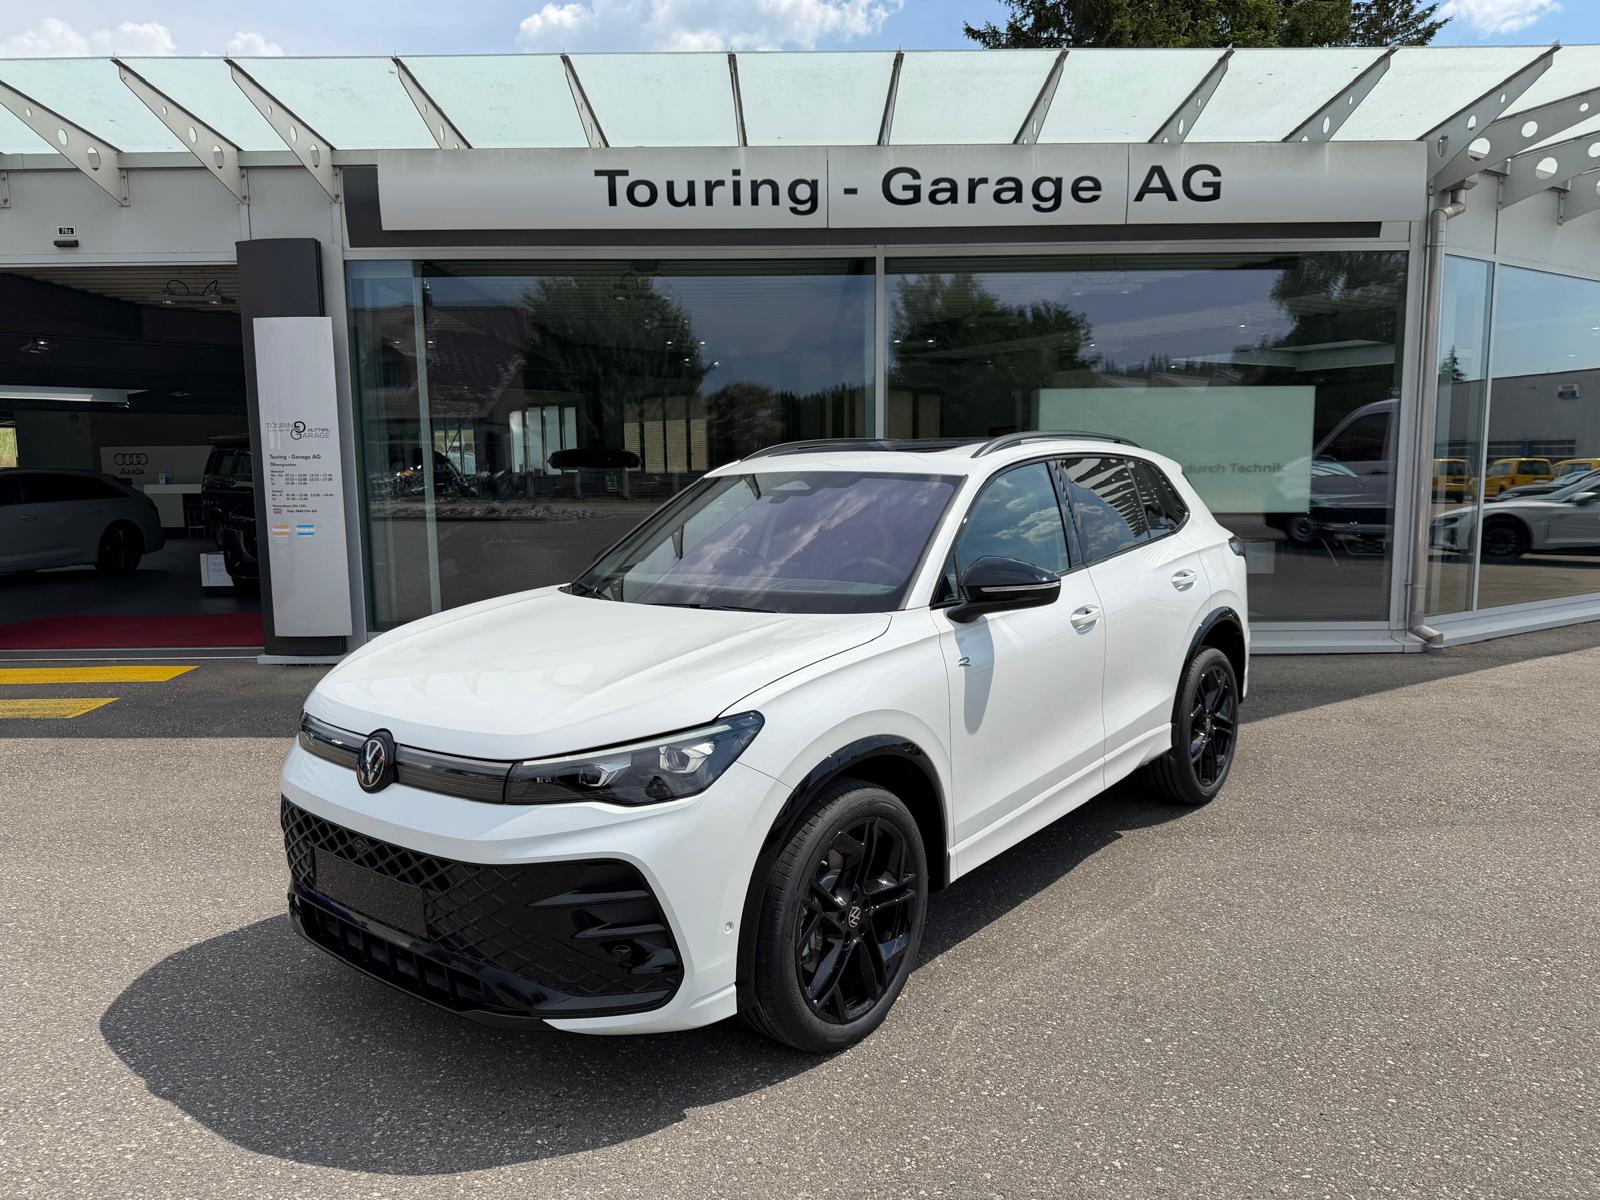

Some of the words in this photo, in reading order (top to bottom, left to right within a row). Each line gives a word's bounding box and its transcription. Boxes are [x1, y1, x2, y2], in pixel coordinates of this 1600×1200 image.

[594, 169, 819, 216] Touring
[843, 187, 858, 195] -
[881, 166, 1102, 213] Garage
[1133, 164, 1222, 203] AG
[119, 467, 145, 475] Audi
[1184, 463, 1226, 474] durch
[1229, 462, 1284, 473] Technik
